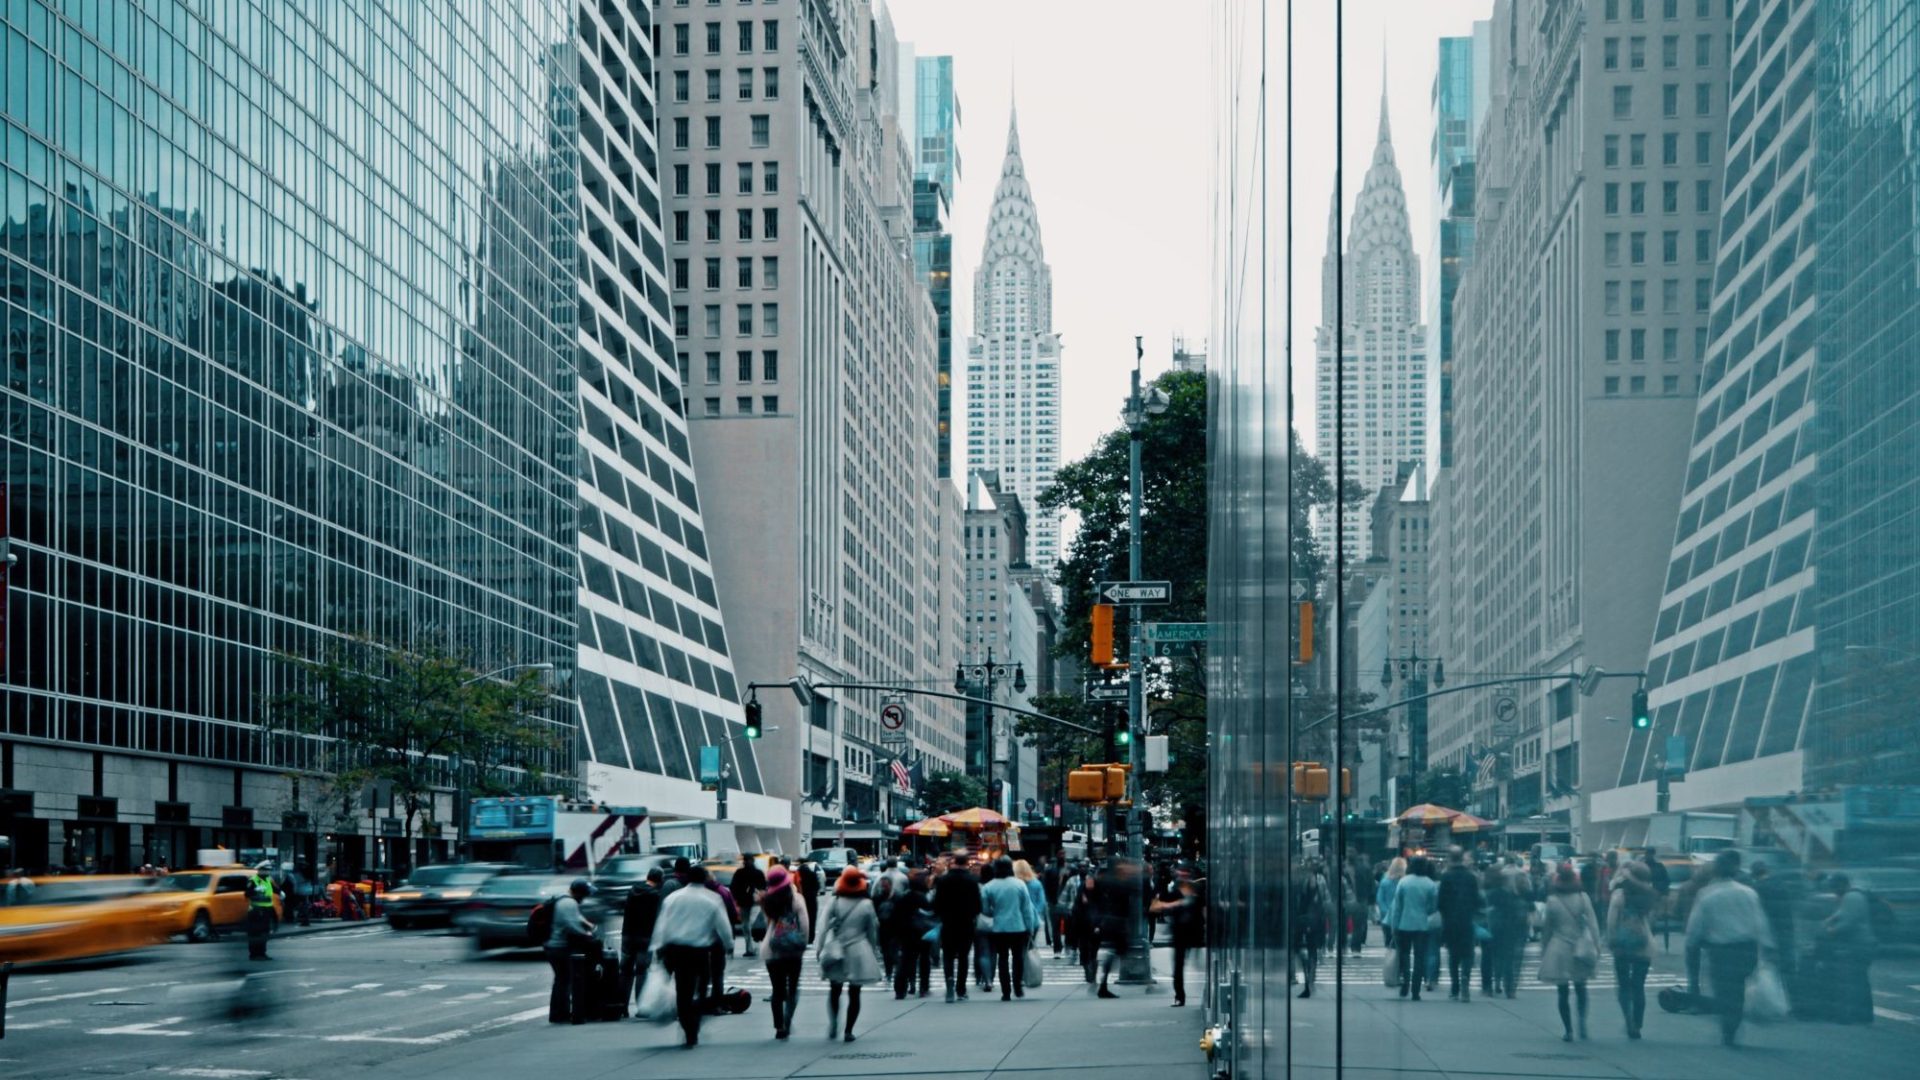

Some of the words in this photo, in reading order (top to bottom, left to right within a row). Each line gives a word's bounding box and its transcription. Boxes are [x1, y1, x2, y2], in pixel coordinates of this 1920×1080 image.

[1110, 588, 1130, 598] ONE
[1140, 588, 1161, 598] WAY
[1162, 643, 1171, 655] 6
[1175, 641, 1186, 649] AV
